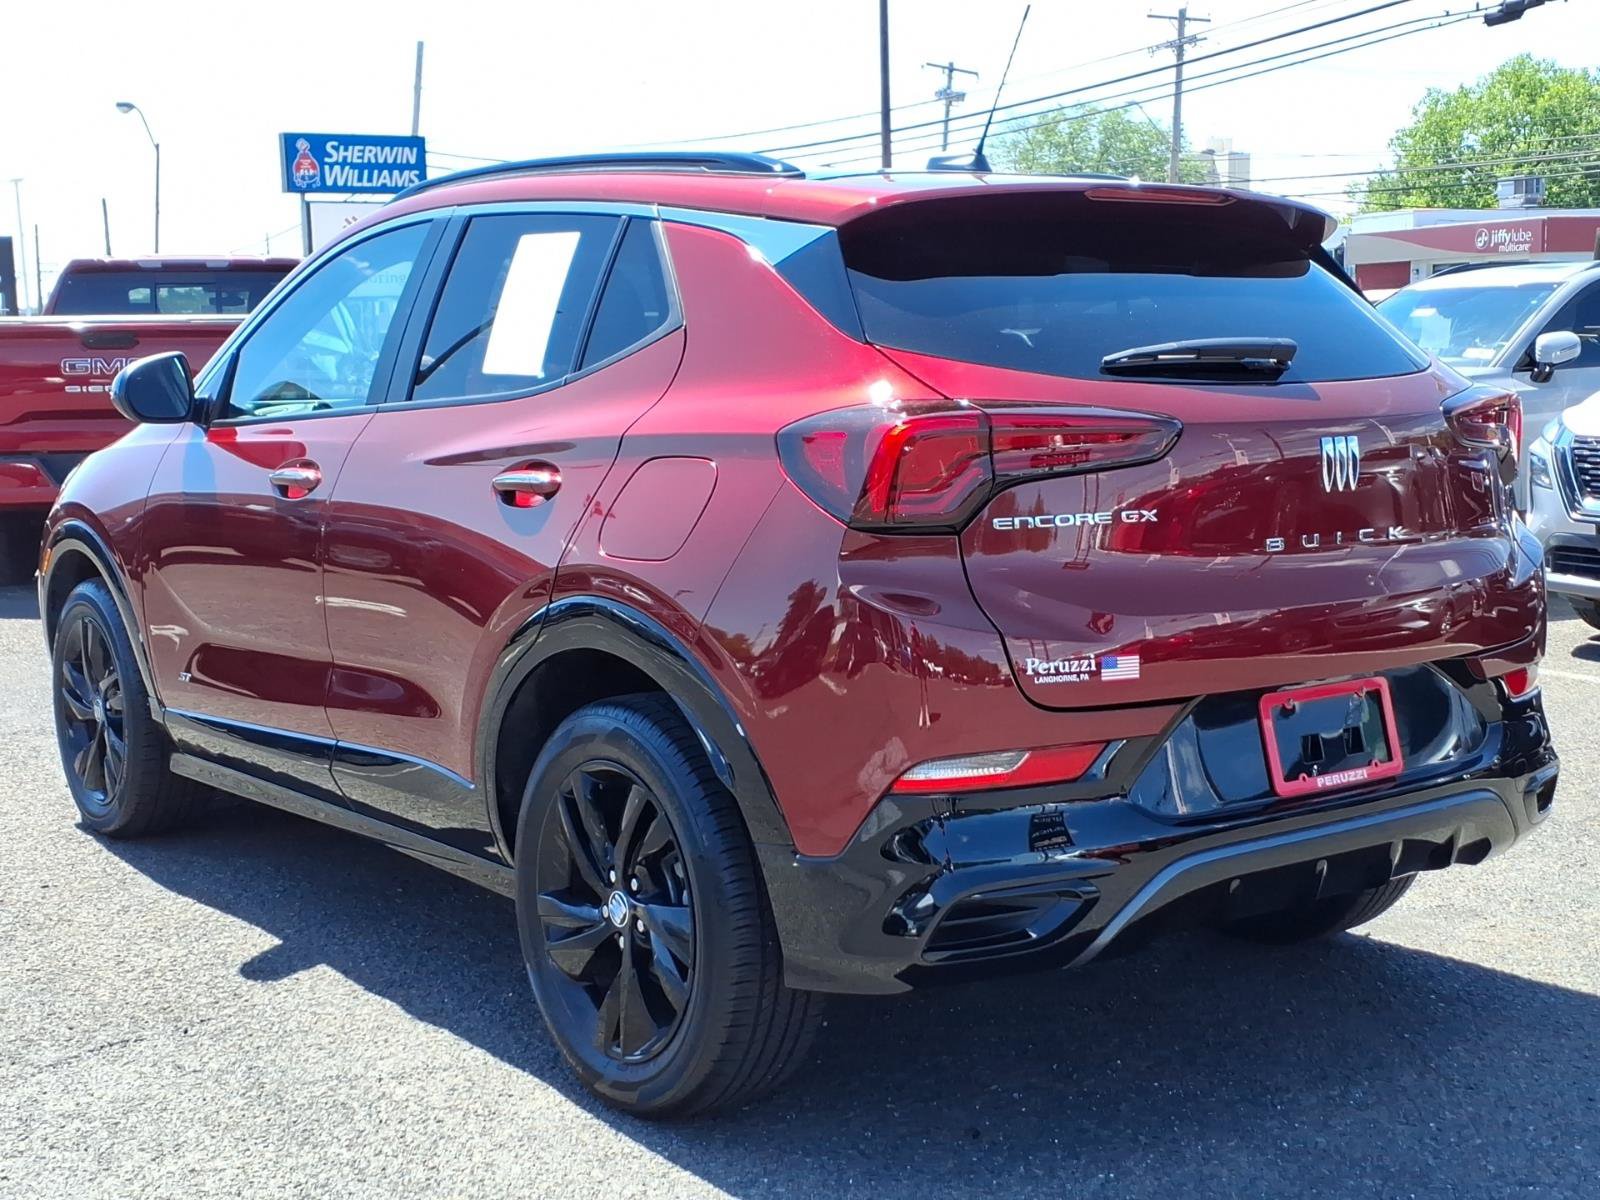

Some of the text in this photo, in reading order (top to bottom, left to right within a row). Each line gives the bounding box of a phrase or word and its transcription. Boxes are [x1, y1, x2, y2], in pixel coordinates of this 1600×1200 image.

[324, 141, 417, 164] SHERWIN
[324, 164, 420, 187] WILLIAMS
[61, 357, 138, 375] GM
[992, 508, 1159, 530] ENCORE GX
[1265, 525, 1410, 553] BUICK
[1025, 653, 1097, 675] Peruzzi
[1034, 672, 1090, 684] LANGHORNE, PA
[1316, 768, 1369, 788] PERUZZI
